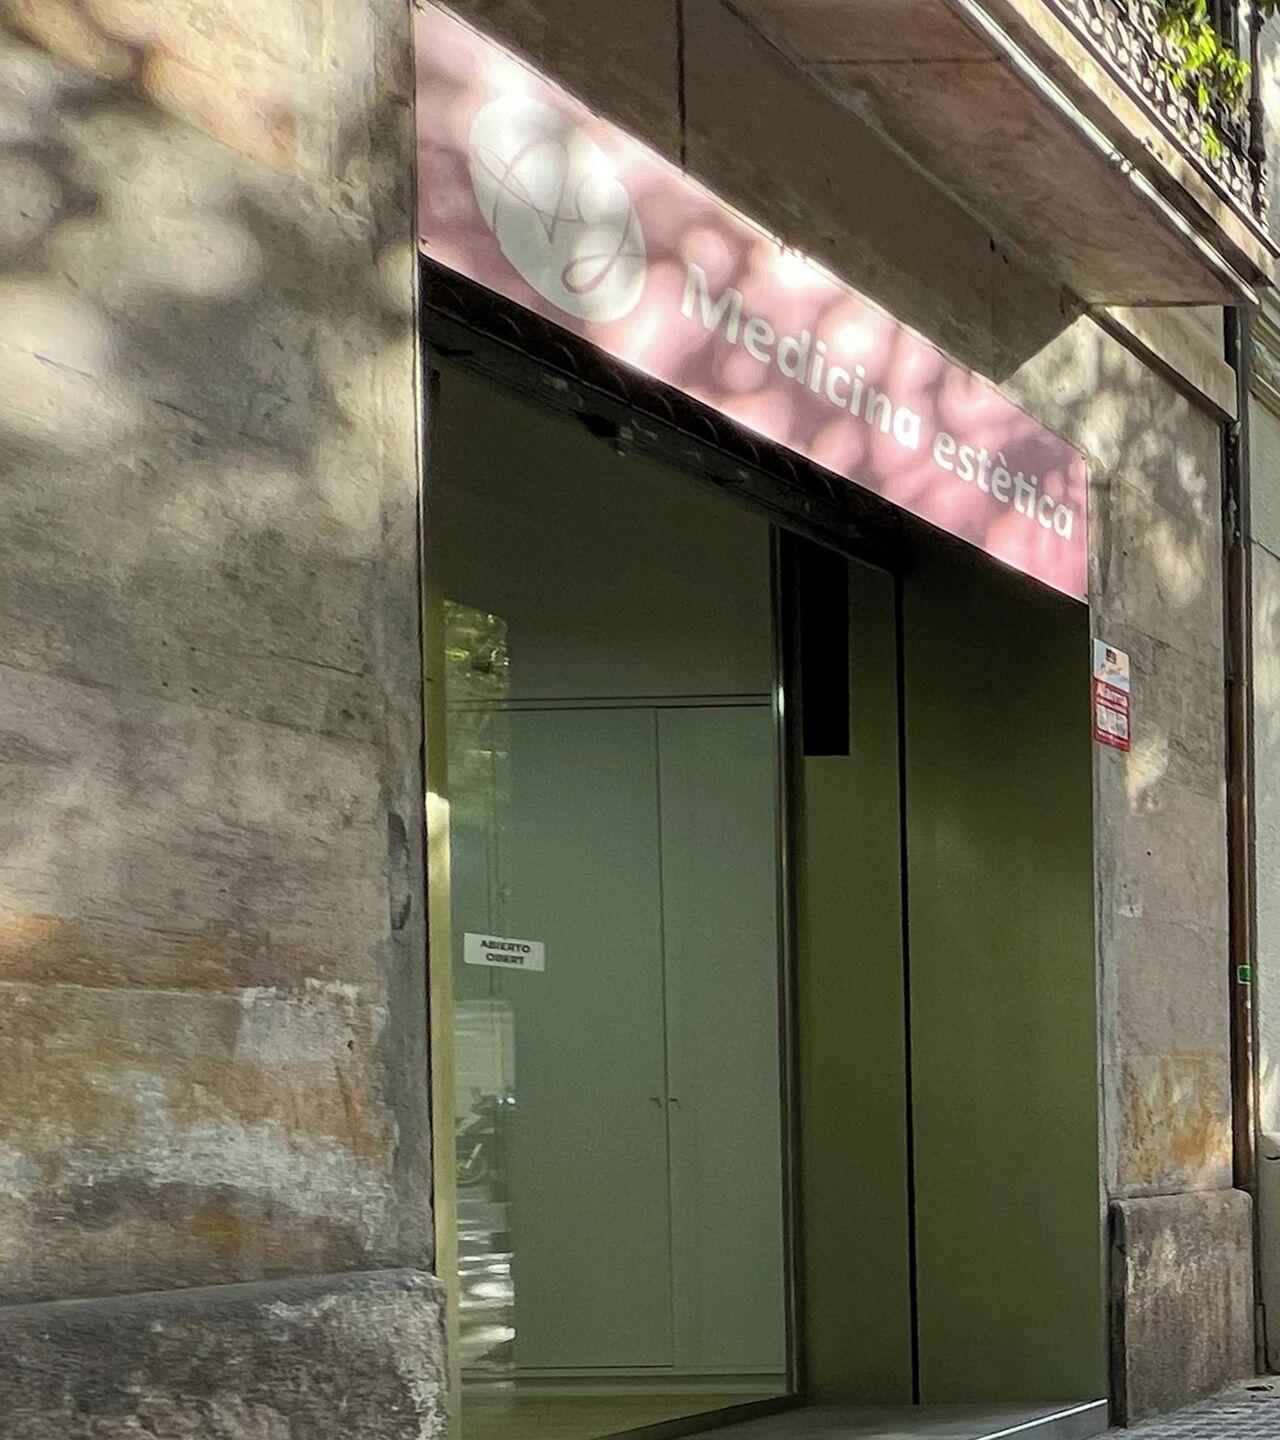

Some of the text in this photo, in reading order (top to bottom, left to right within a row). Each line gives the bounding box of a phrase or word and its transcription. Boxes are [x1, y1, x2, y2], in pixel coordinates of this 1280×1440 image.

[681, 263, 1074, 541] Medicina estètica
[480, 940, 531, 953] ABIERTO
[486, 952, 525, 965] OBERT
